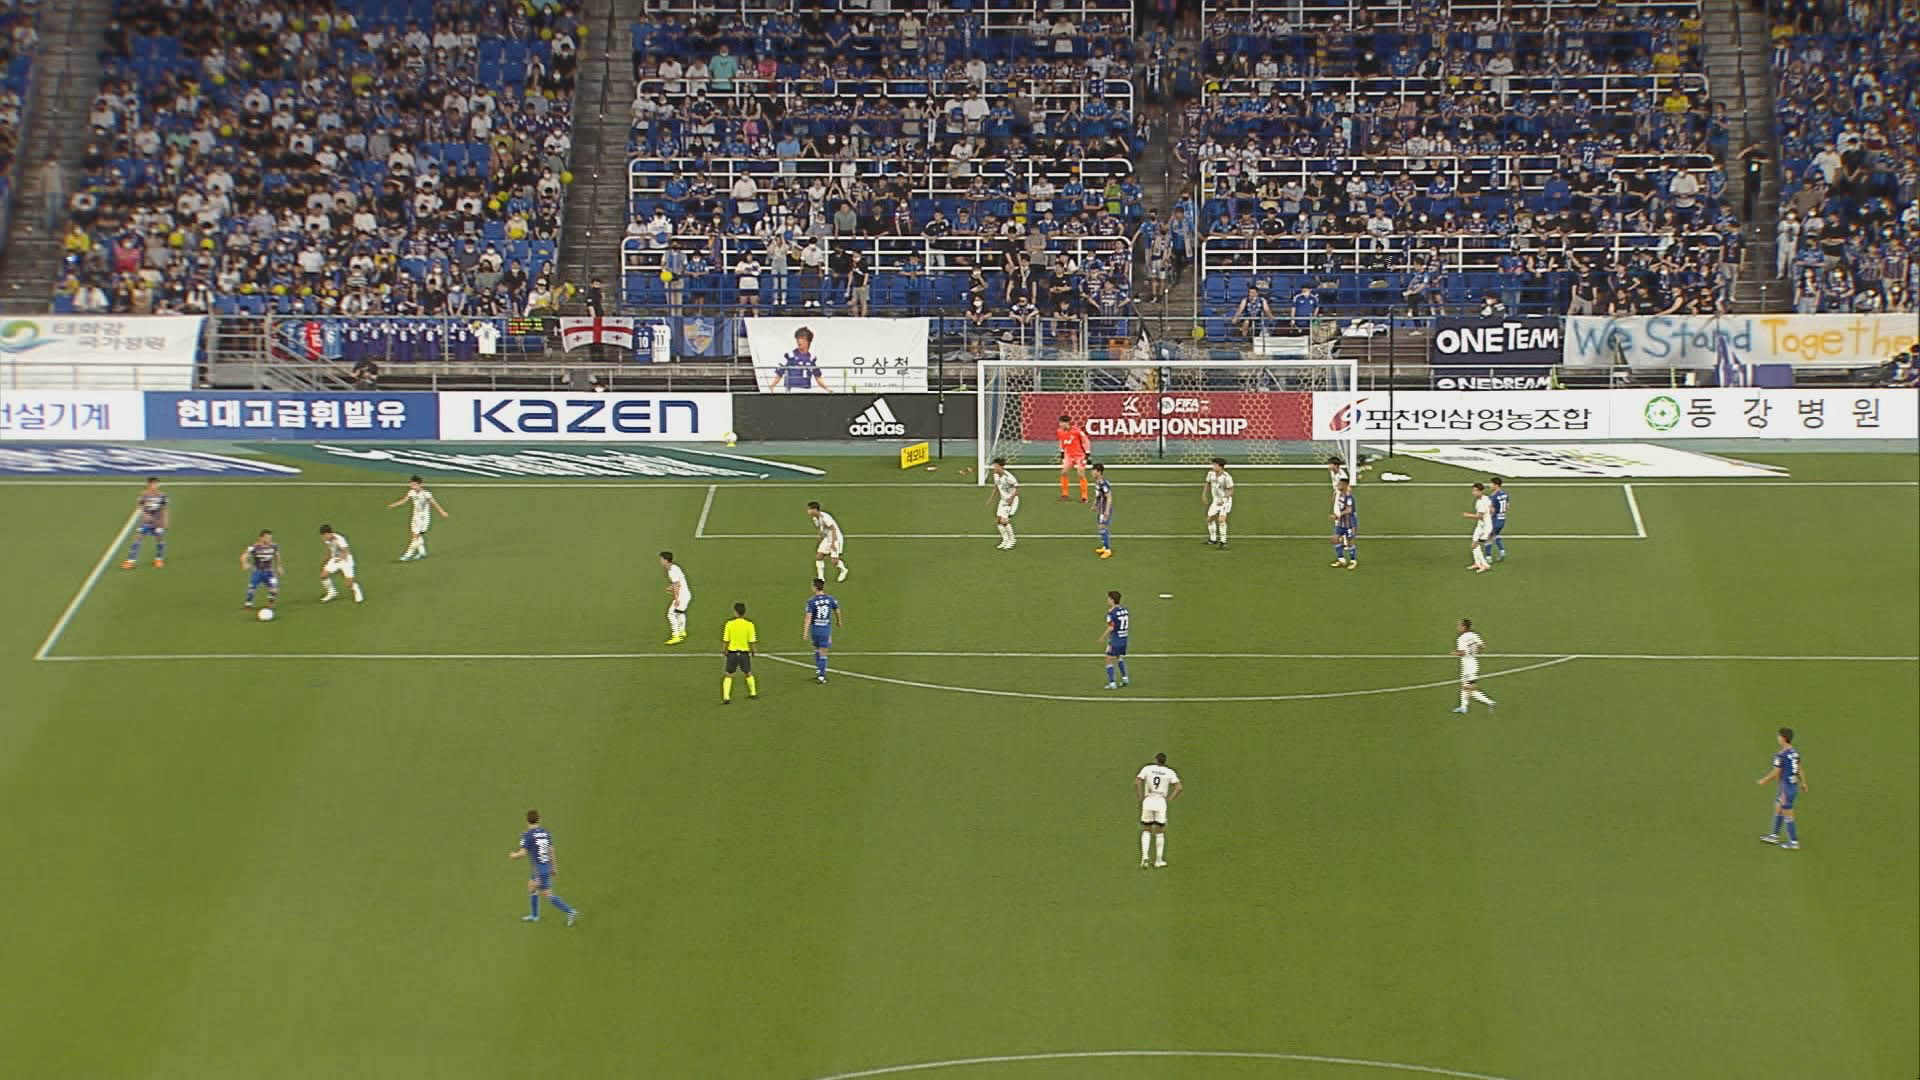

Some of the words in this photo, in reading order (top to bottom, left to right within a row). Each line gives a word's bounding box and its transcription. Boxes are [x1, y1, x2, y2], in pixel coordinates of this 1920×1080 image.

[1572, 319, 1632, 356] We
[1642, 316, 1753, 358] Stand
[1759, 318, 1918, 360] Togethe
[852, 356, 909, 375] 유상철
[177, 400, 406, 428] 현대고급휘발유
[1365, 408, 1591, 431] 포천인삼영농조합
[1687, 398, 1880, 429] 동강병원
[850, 422, 905, 436] adidas
[1085, 418, 1248, 436] CHAMPIONSHIP
[1153, 776, 1160, 790] 9
